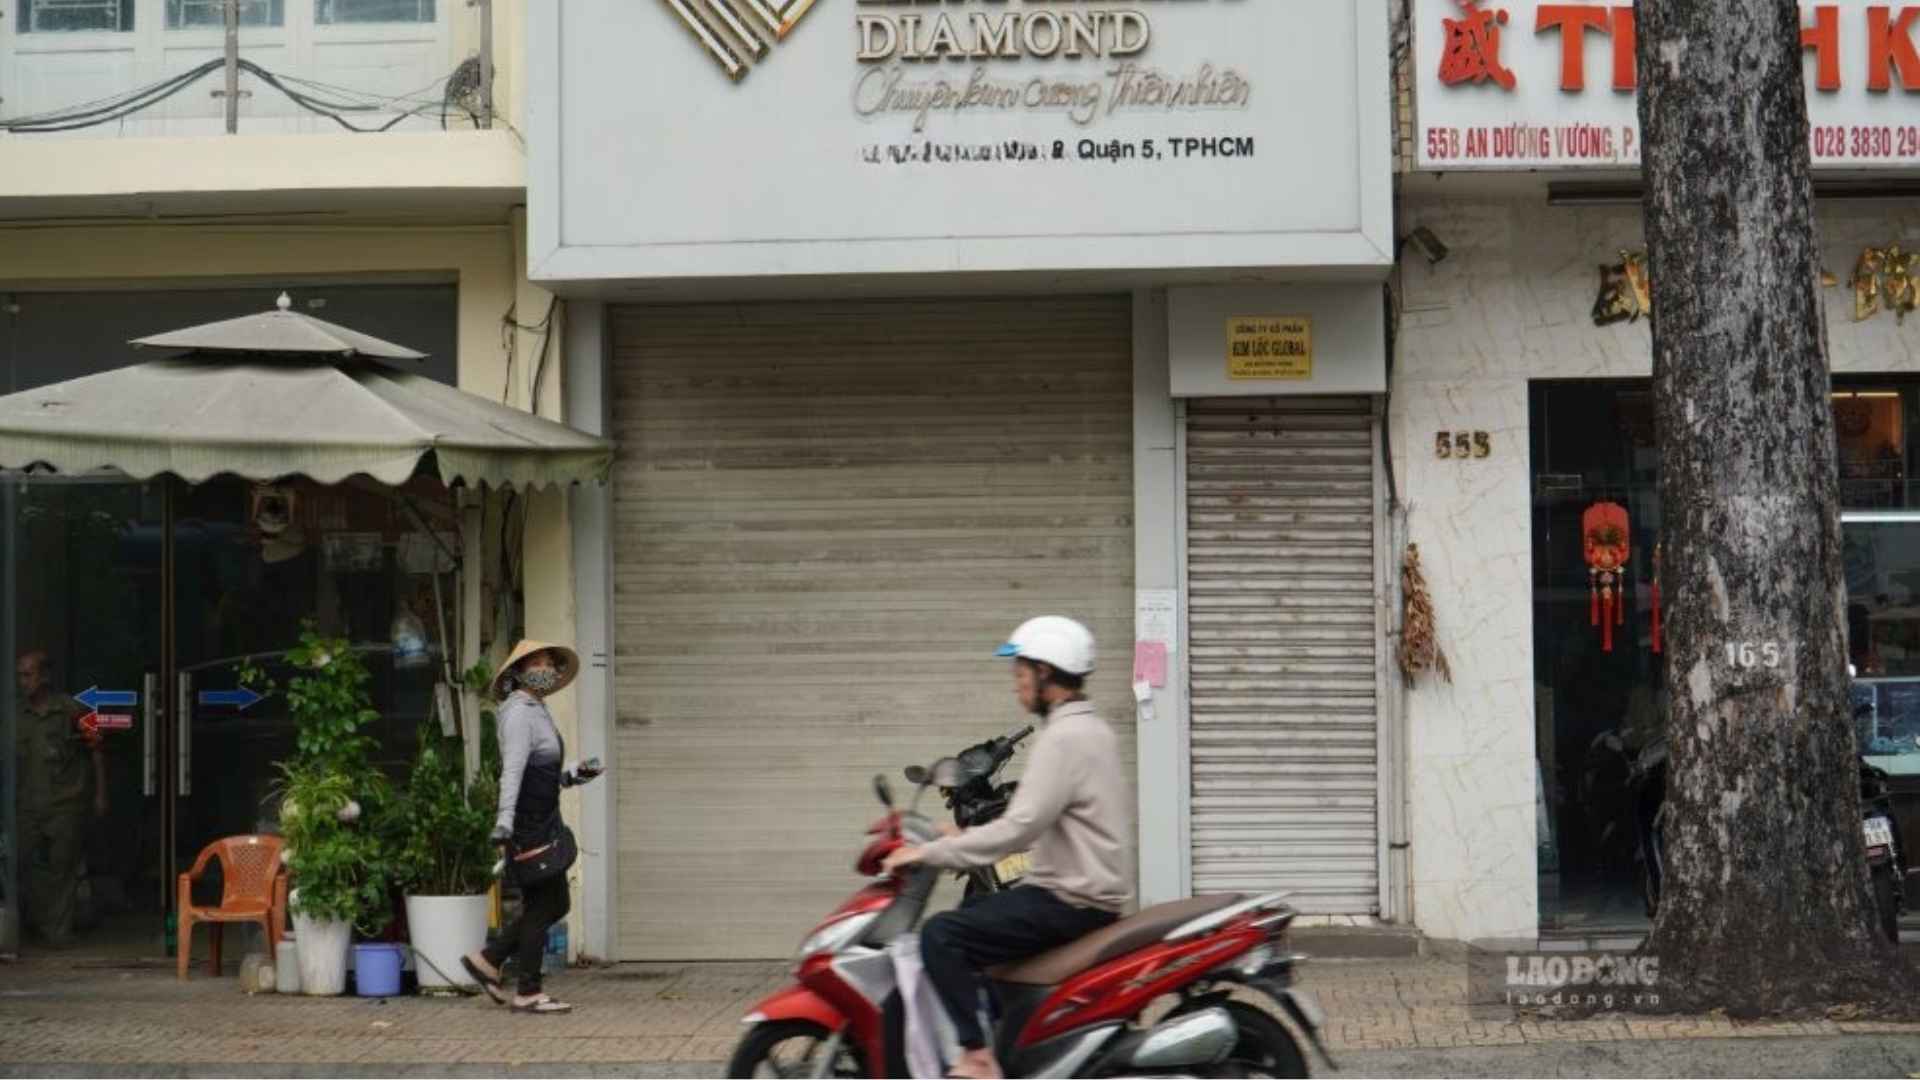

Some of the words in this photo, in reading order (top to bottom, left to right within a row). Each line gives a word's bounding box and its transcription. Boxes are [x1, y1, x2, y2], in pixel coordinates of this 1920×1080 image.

[856, 11, 1150, 60] DIAMOND
[1077, 138, 1135, 163] Quận
[1141, 139, 1162, 161] 5,
[1168, 137, 1256, 160] TPHCM
[1466, 127, 1488, 158] AN
[1493, 122, 1550, 158] DƯƠNG
[1815, 126, 1845, 157] 028
[1850, 126, 1892, 157] 3830
[1897, 126, 1920, 157] 29
[1725, 642, 1779, 668] 165
